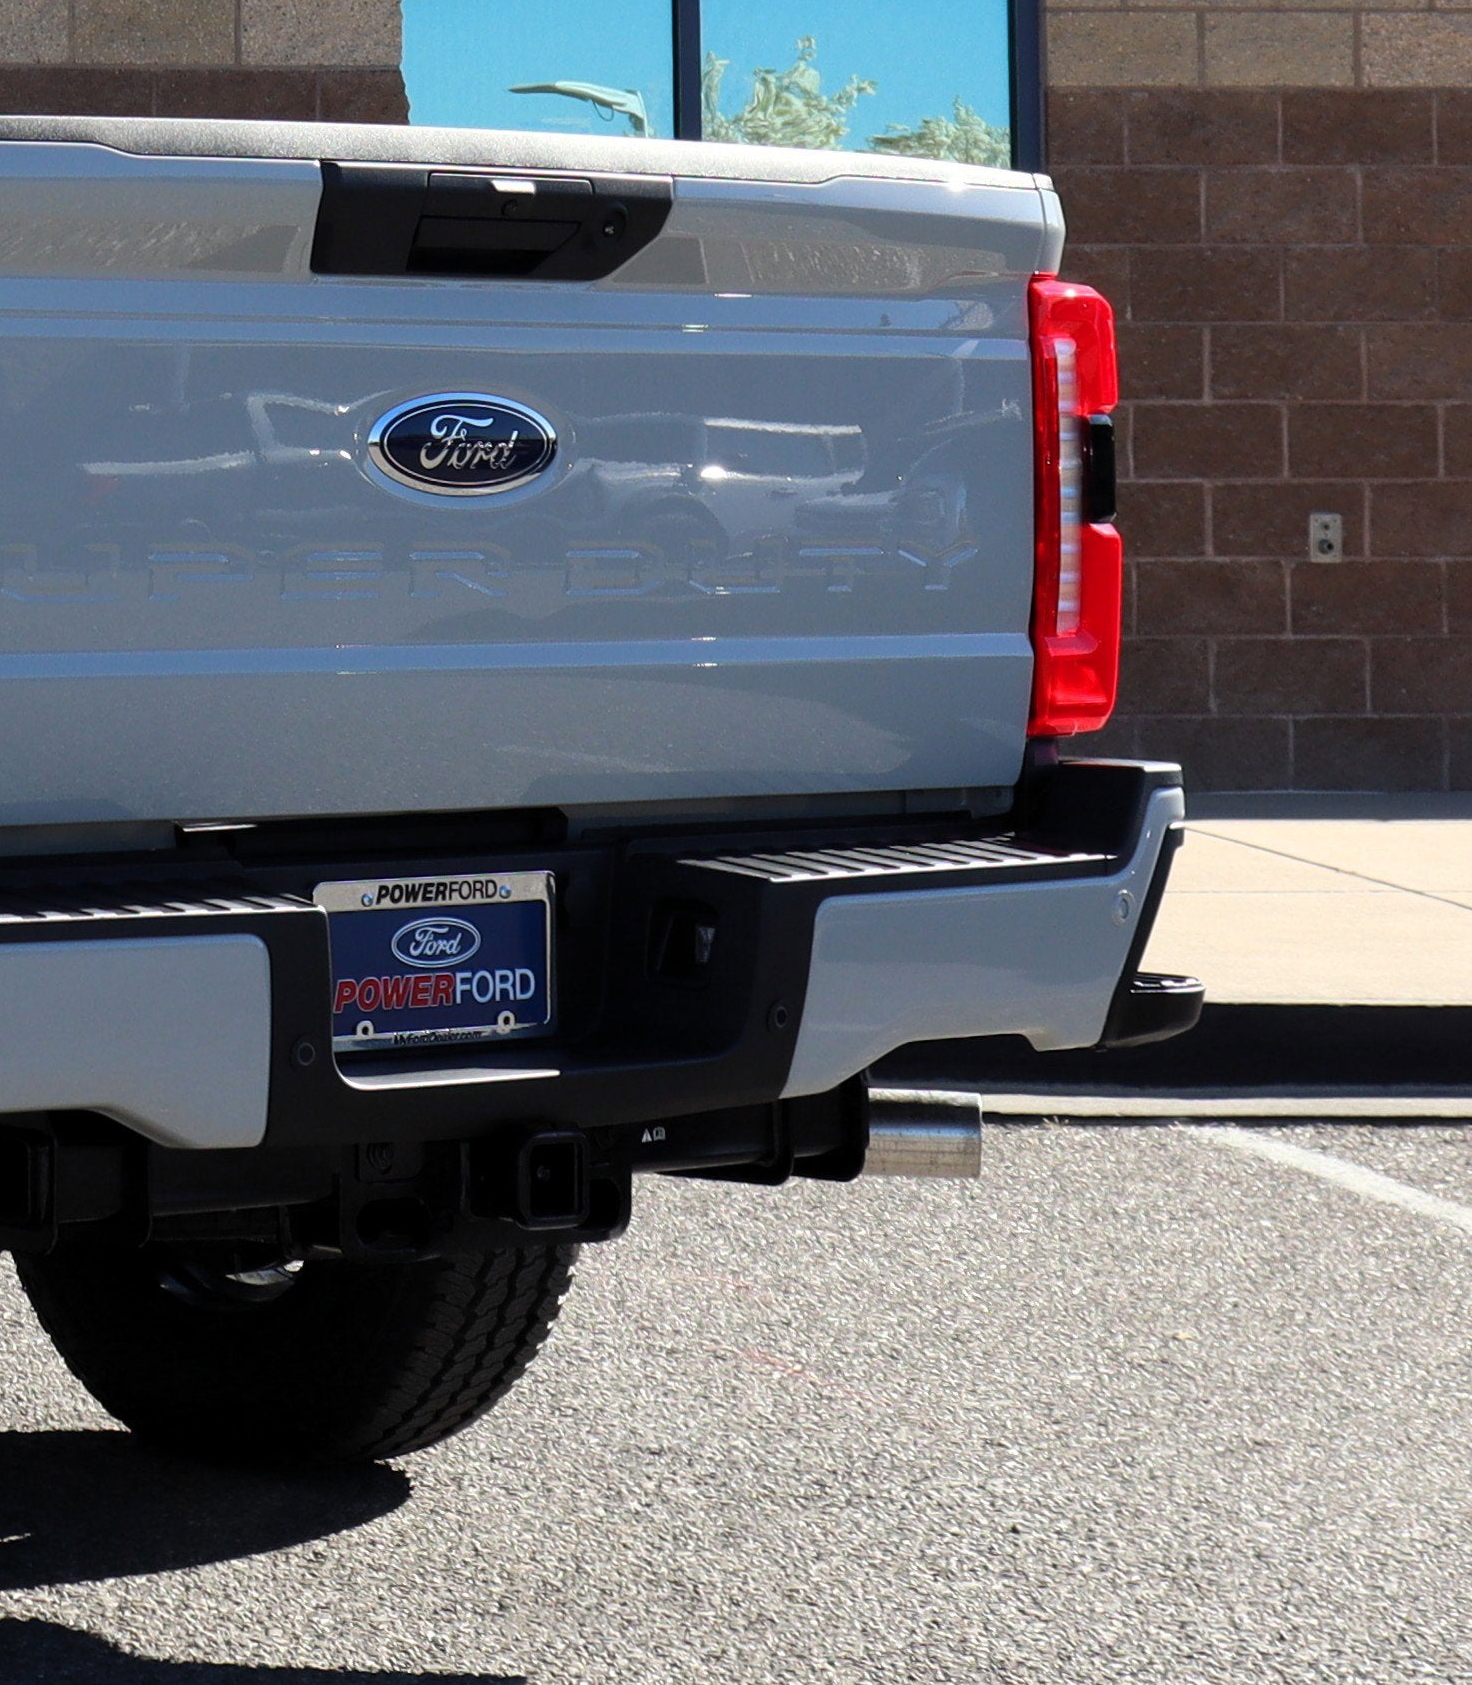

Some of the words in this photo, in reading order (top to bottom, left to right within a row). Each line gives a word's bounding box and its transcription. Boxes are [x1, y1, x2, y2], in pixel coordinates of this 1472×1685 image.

[418, 413, 519, 471] Ford
[563, 536, 980, 598] DUTY
[375, 879, 498, 905] POWERFORD
[409, 926, 462, 957] Ford
[333, 968, 536, 1014] POWERFORD
